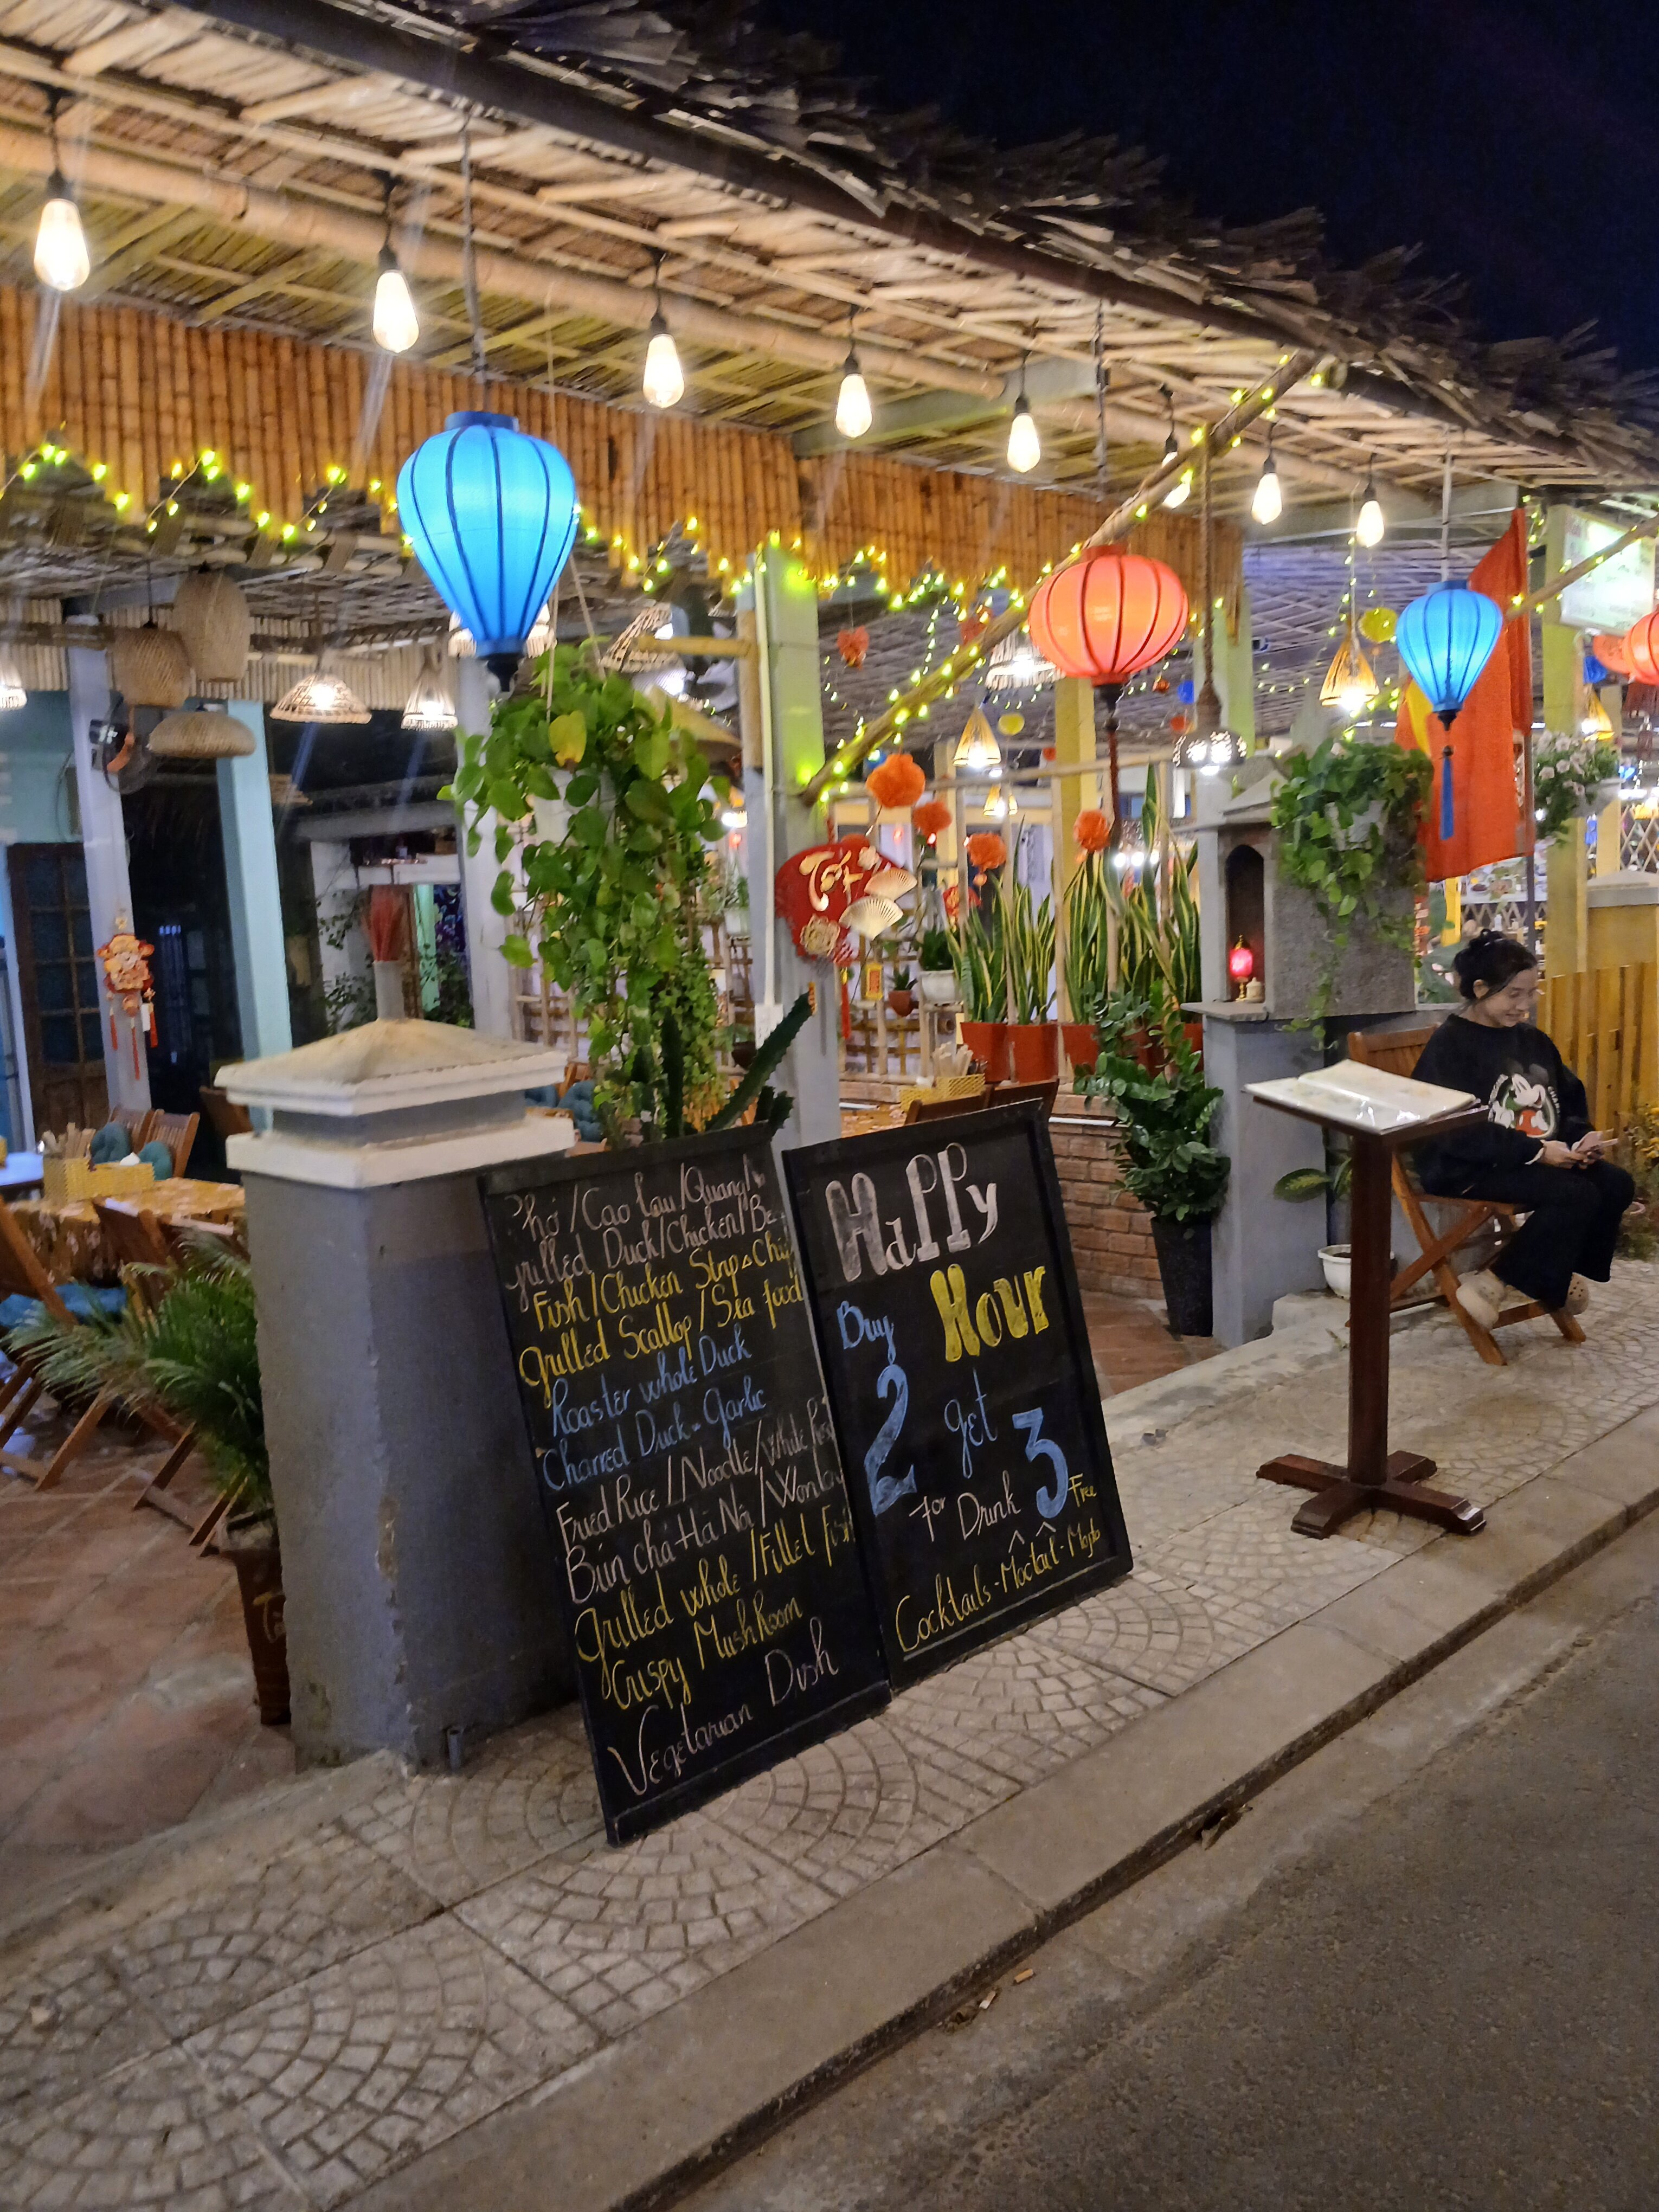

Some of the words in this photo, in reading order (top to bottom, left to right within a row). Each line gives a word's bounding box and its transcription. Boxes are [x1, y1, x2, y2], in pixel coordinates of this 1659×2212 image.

[619, 1301, 692, 1362] Scallop
[698, 1322, 753, 1377] Duck
[837, 1301, 896, 1364] Buy
[864, 1364, 917, 1517] 2
[1012, 1407, 1068, 1519] 3
[556, 1484, 616, 1554] Fried
[616, 1474, 660, 1525] Rice
[956, 1470, 1021, 1540] Drink
[1068, 1472, 1097, 1508] Free
[764, 1616, 839, 1707] Dish
